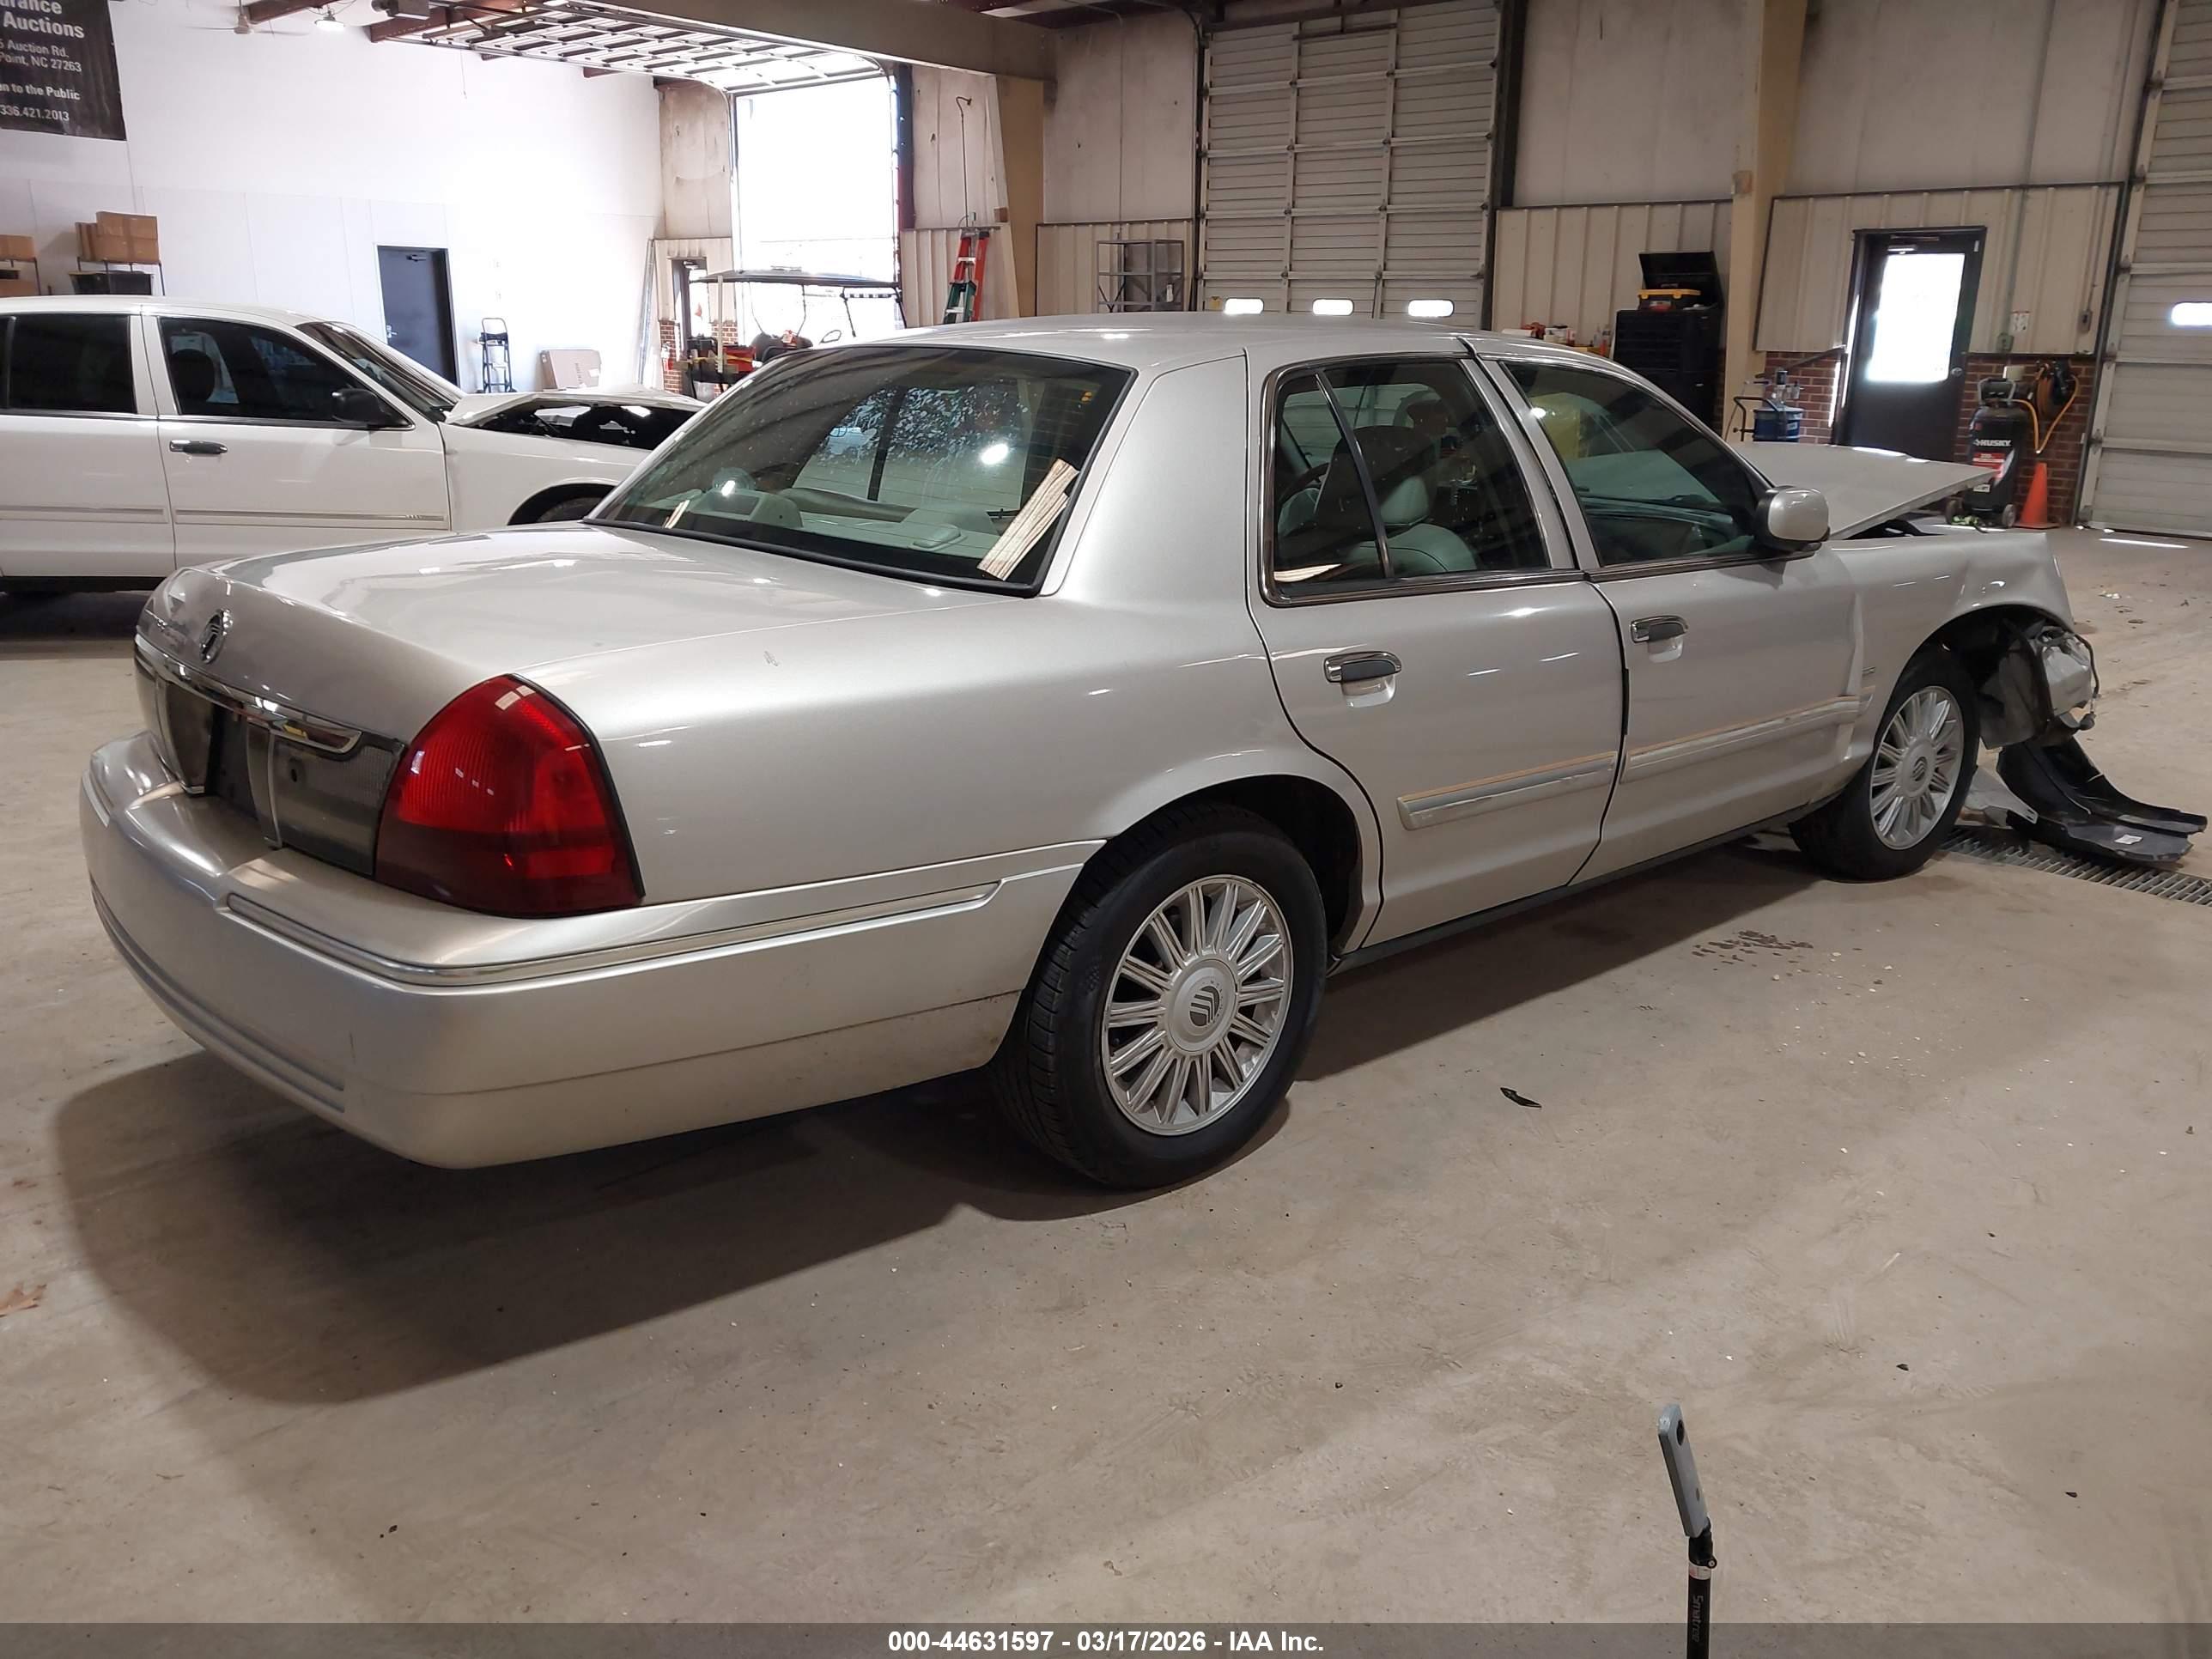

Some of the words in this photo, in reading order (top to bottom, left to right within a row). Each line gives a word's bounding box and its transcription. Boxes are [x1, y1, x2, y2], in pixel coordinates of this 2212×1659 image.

[3, 11, 84, 39] Auctions
[8, 40, 49, 54] Auction
[51, 45, 69, 58] Rd.
[30, 55, 48, 68] NC
[51, 58, 82, 72] 27263
[11, 83, 23, 94] to
[25, 84, 44, 95] the
[46, 87, 81, 100] Public
